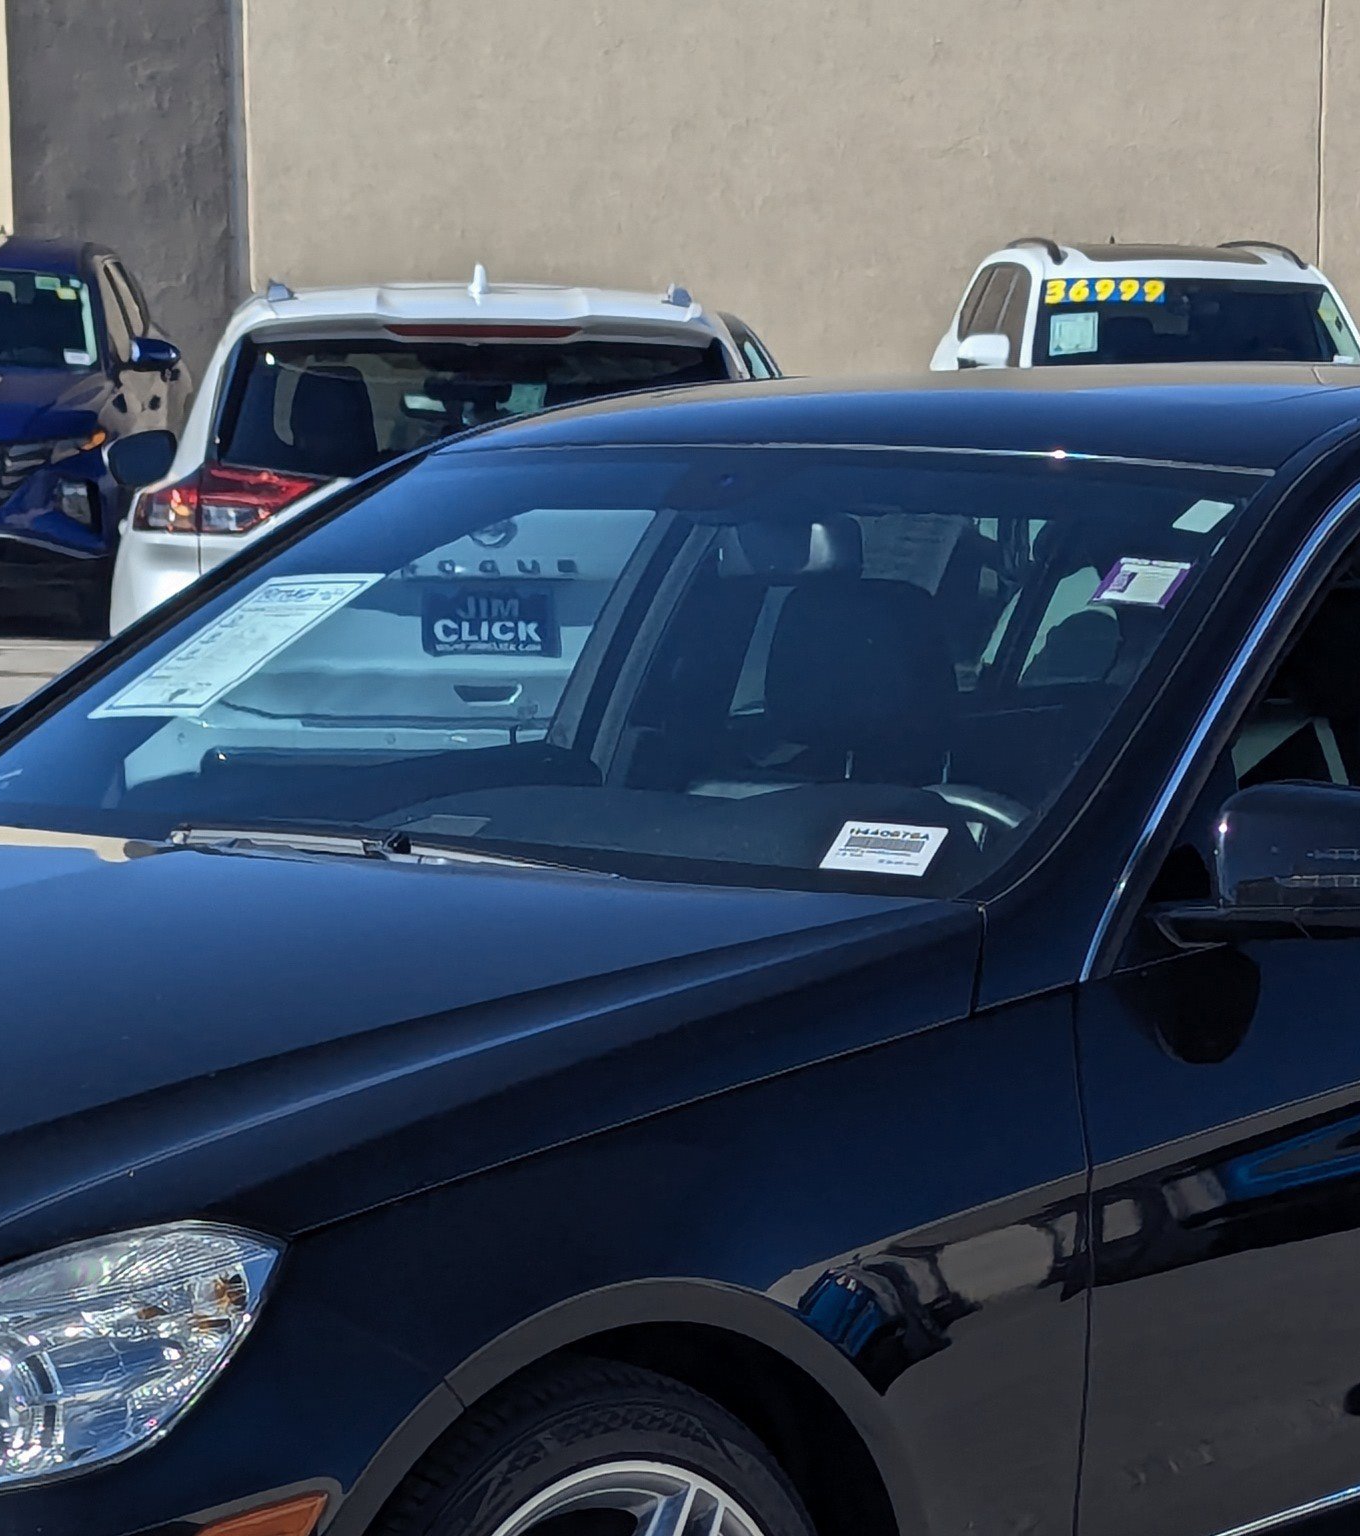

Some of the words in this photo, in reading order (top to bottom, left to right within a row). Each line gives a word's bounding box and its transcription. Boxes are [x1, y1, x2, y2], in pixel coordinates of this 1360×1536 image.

[1044, 279, 1165, 304] 36999
[456, 596, 519, 619] JIM
[433, 618, 542, 642] CLICK
